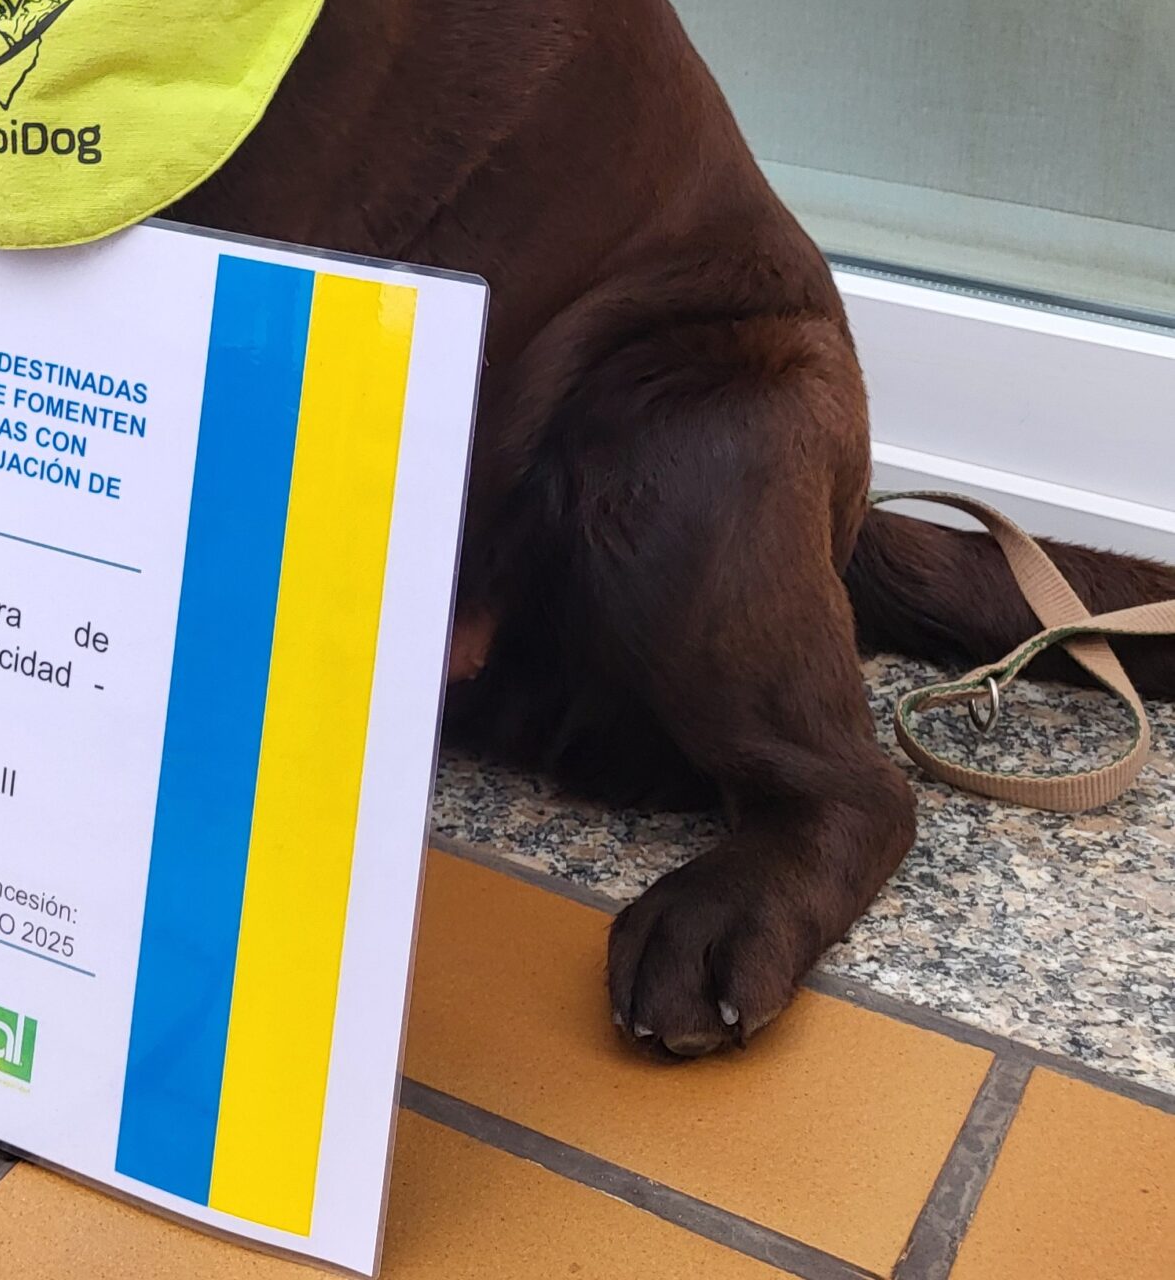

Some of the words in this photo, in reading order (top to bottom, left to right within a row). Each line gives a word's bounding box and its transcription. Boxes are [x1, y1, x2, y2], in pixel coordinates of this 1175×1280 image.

[14, 388, 146, 438] FOMENTEN
[36, 427, 87, 457] CON
[88, 472, 121, 499] DE
[75, 622, 108, 653] de
[1, 767, 16, 797] II
[21, 922, 74, 957] 2025
